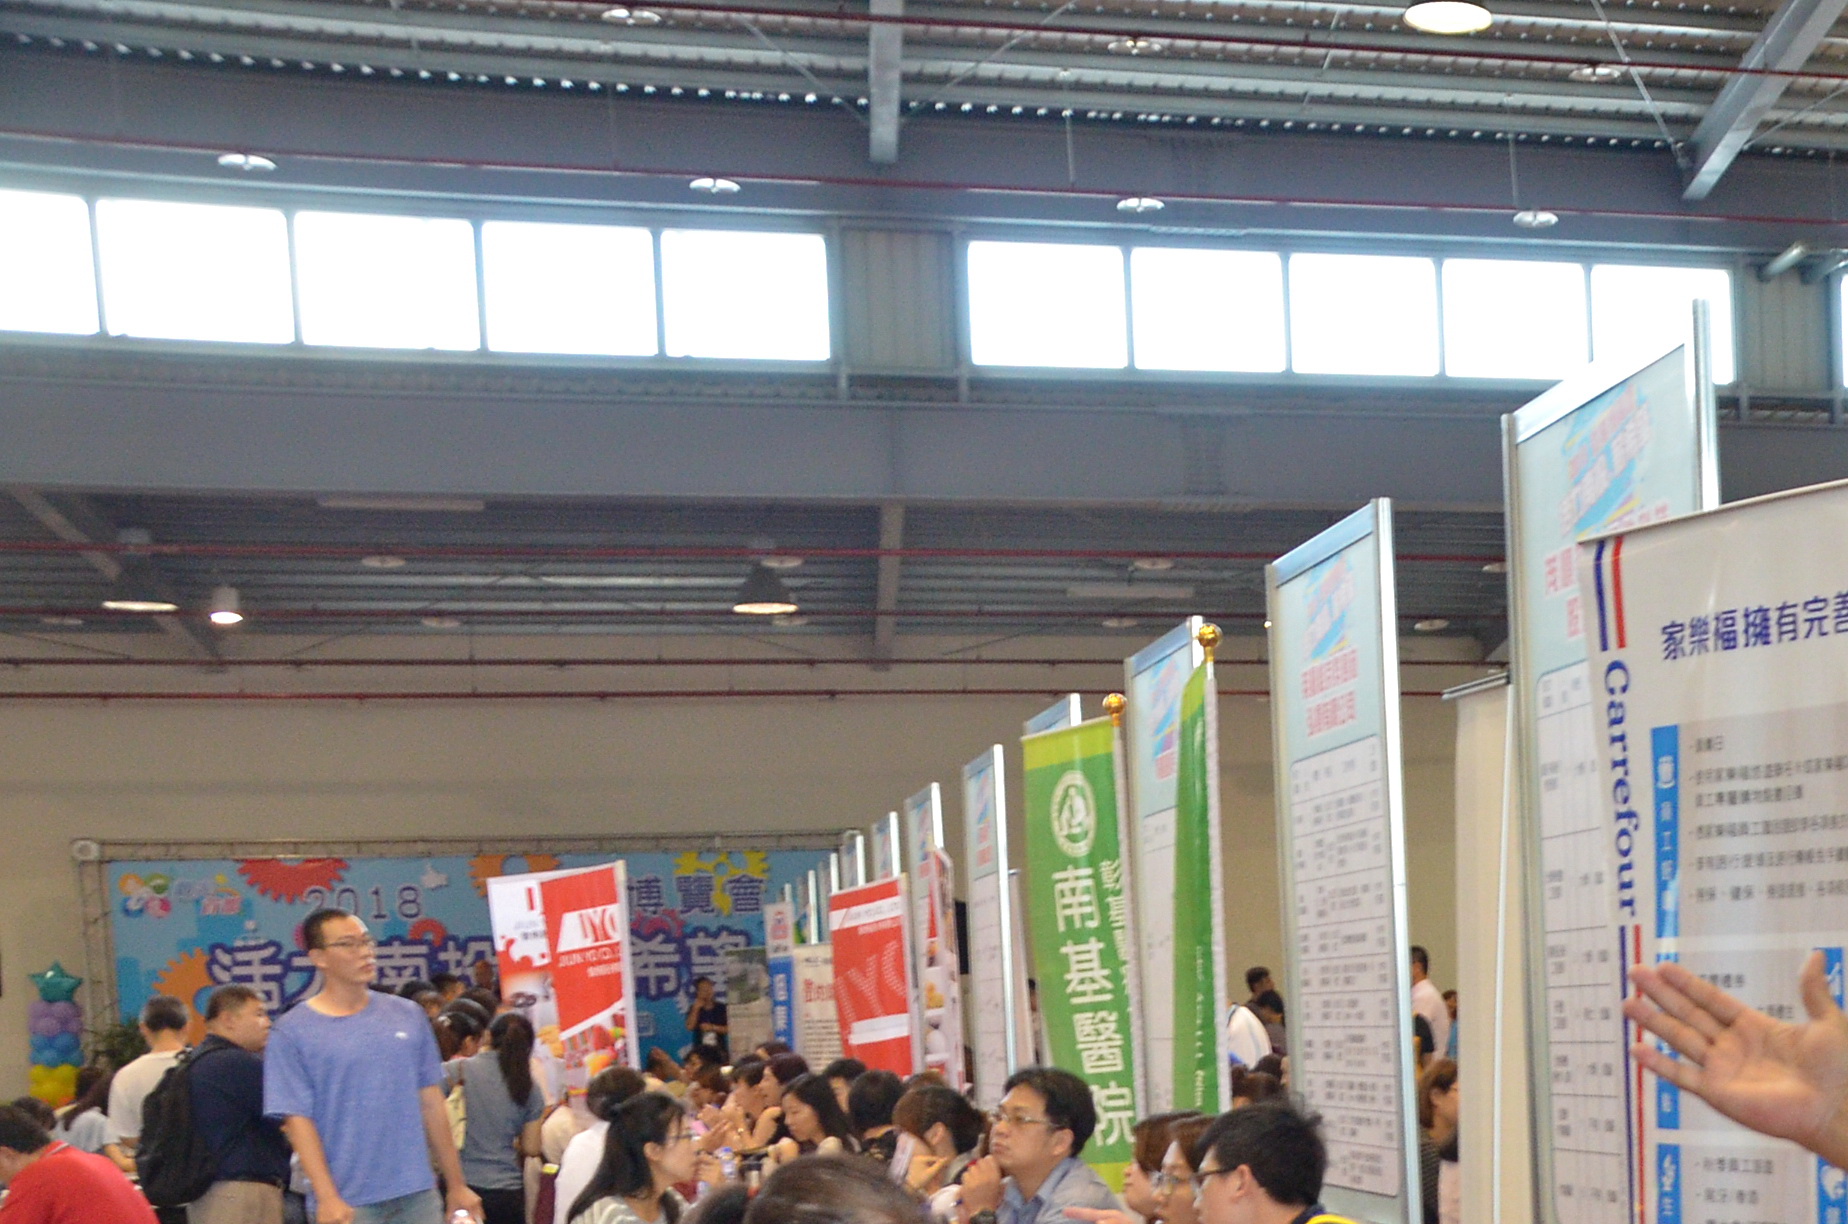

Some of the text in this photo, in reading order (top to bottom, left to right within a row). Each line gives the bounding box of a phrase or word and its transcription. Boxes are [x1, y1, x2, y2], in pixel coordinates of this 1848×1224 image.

[1603, 659, 1641, 917] Carrefour
[1052, 866, 1135, 1146] 南基醫院
